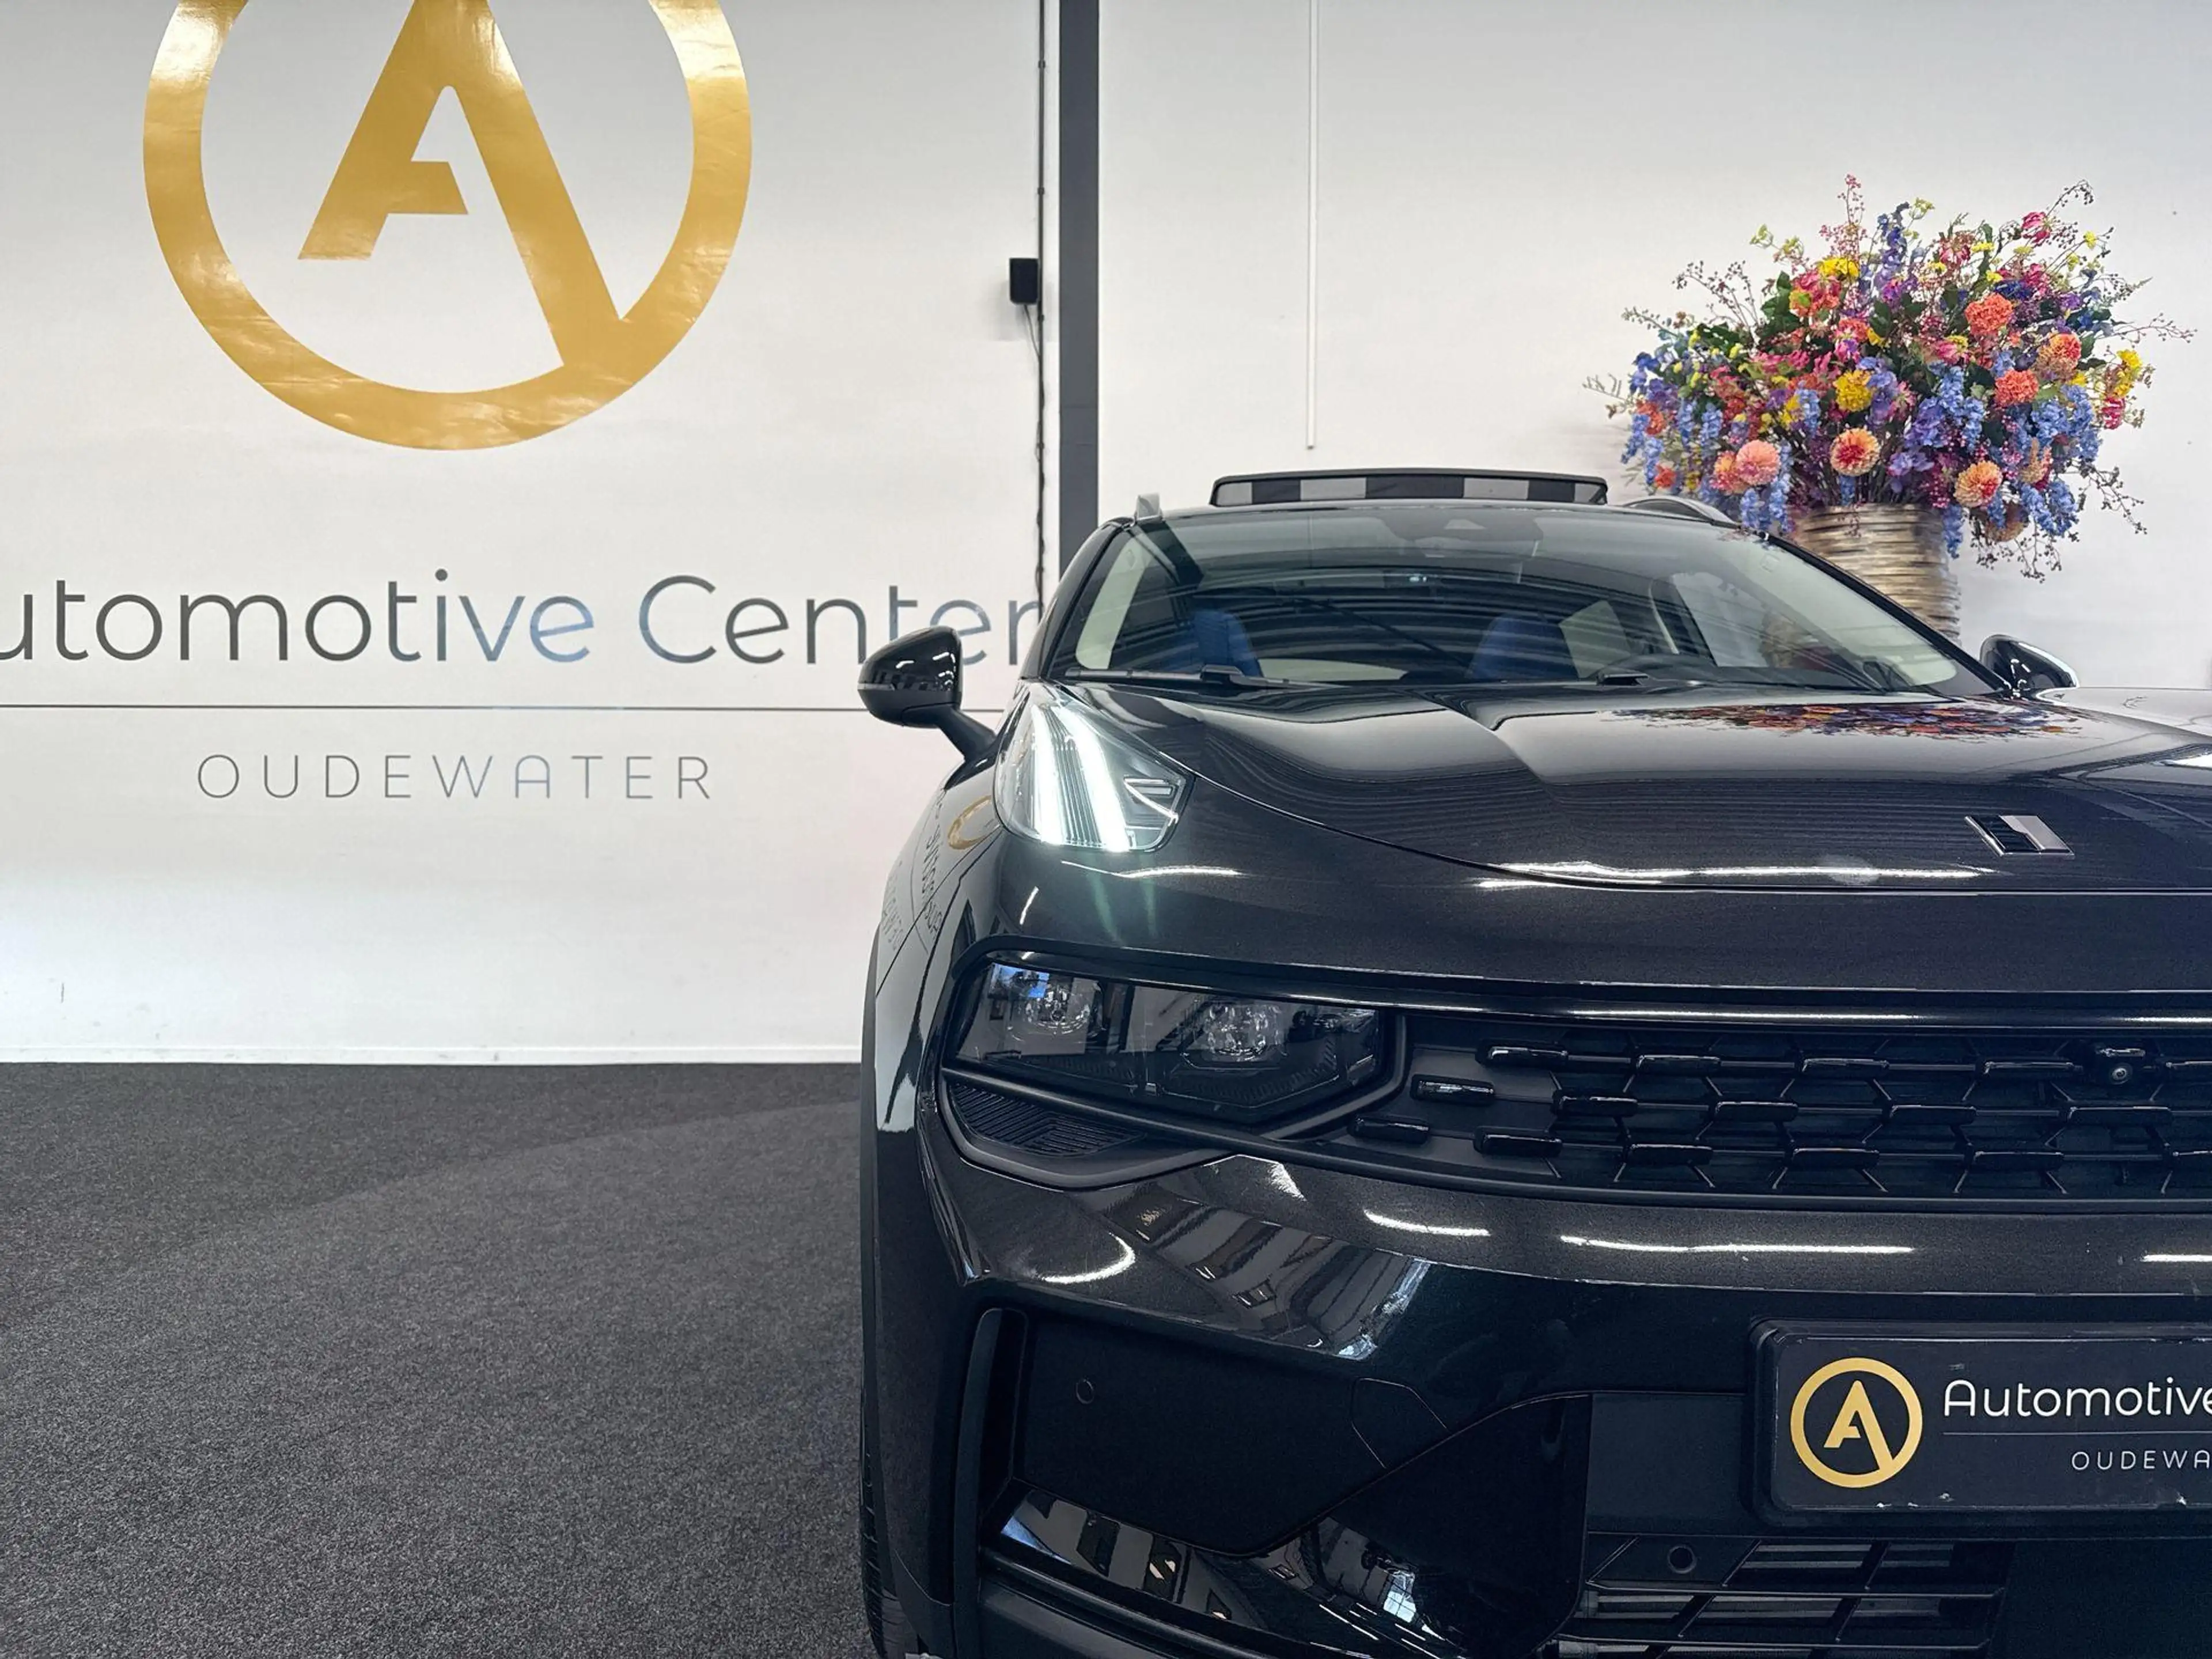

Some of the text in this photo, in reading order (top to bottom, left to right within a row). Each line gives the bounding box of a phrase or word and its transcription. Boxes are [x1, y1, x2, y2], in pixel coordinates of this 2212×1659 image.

[0, 569, 1039, 665] utomotive Center
[198, 754, 710, 800] OUDEWATER
[2071, 1449, 2210, 1470] OUDEWA
